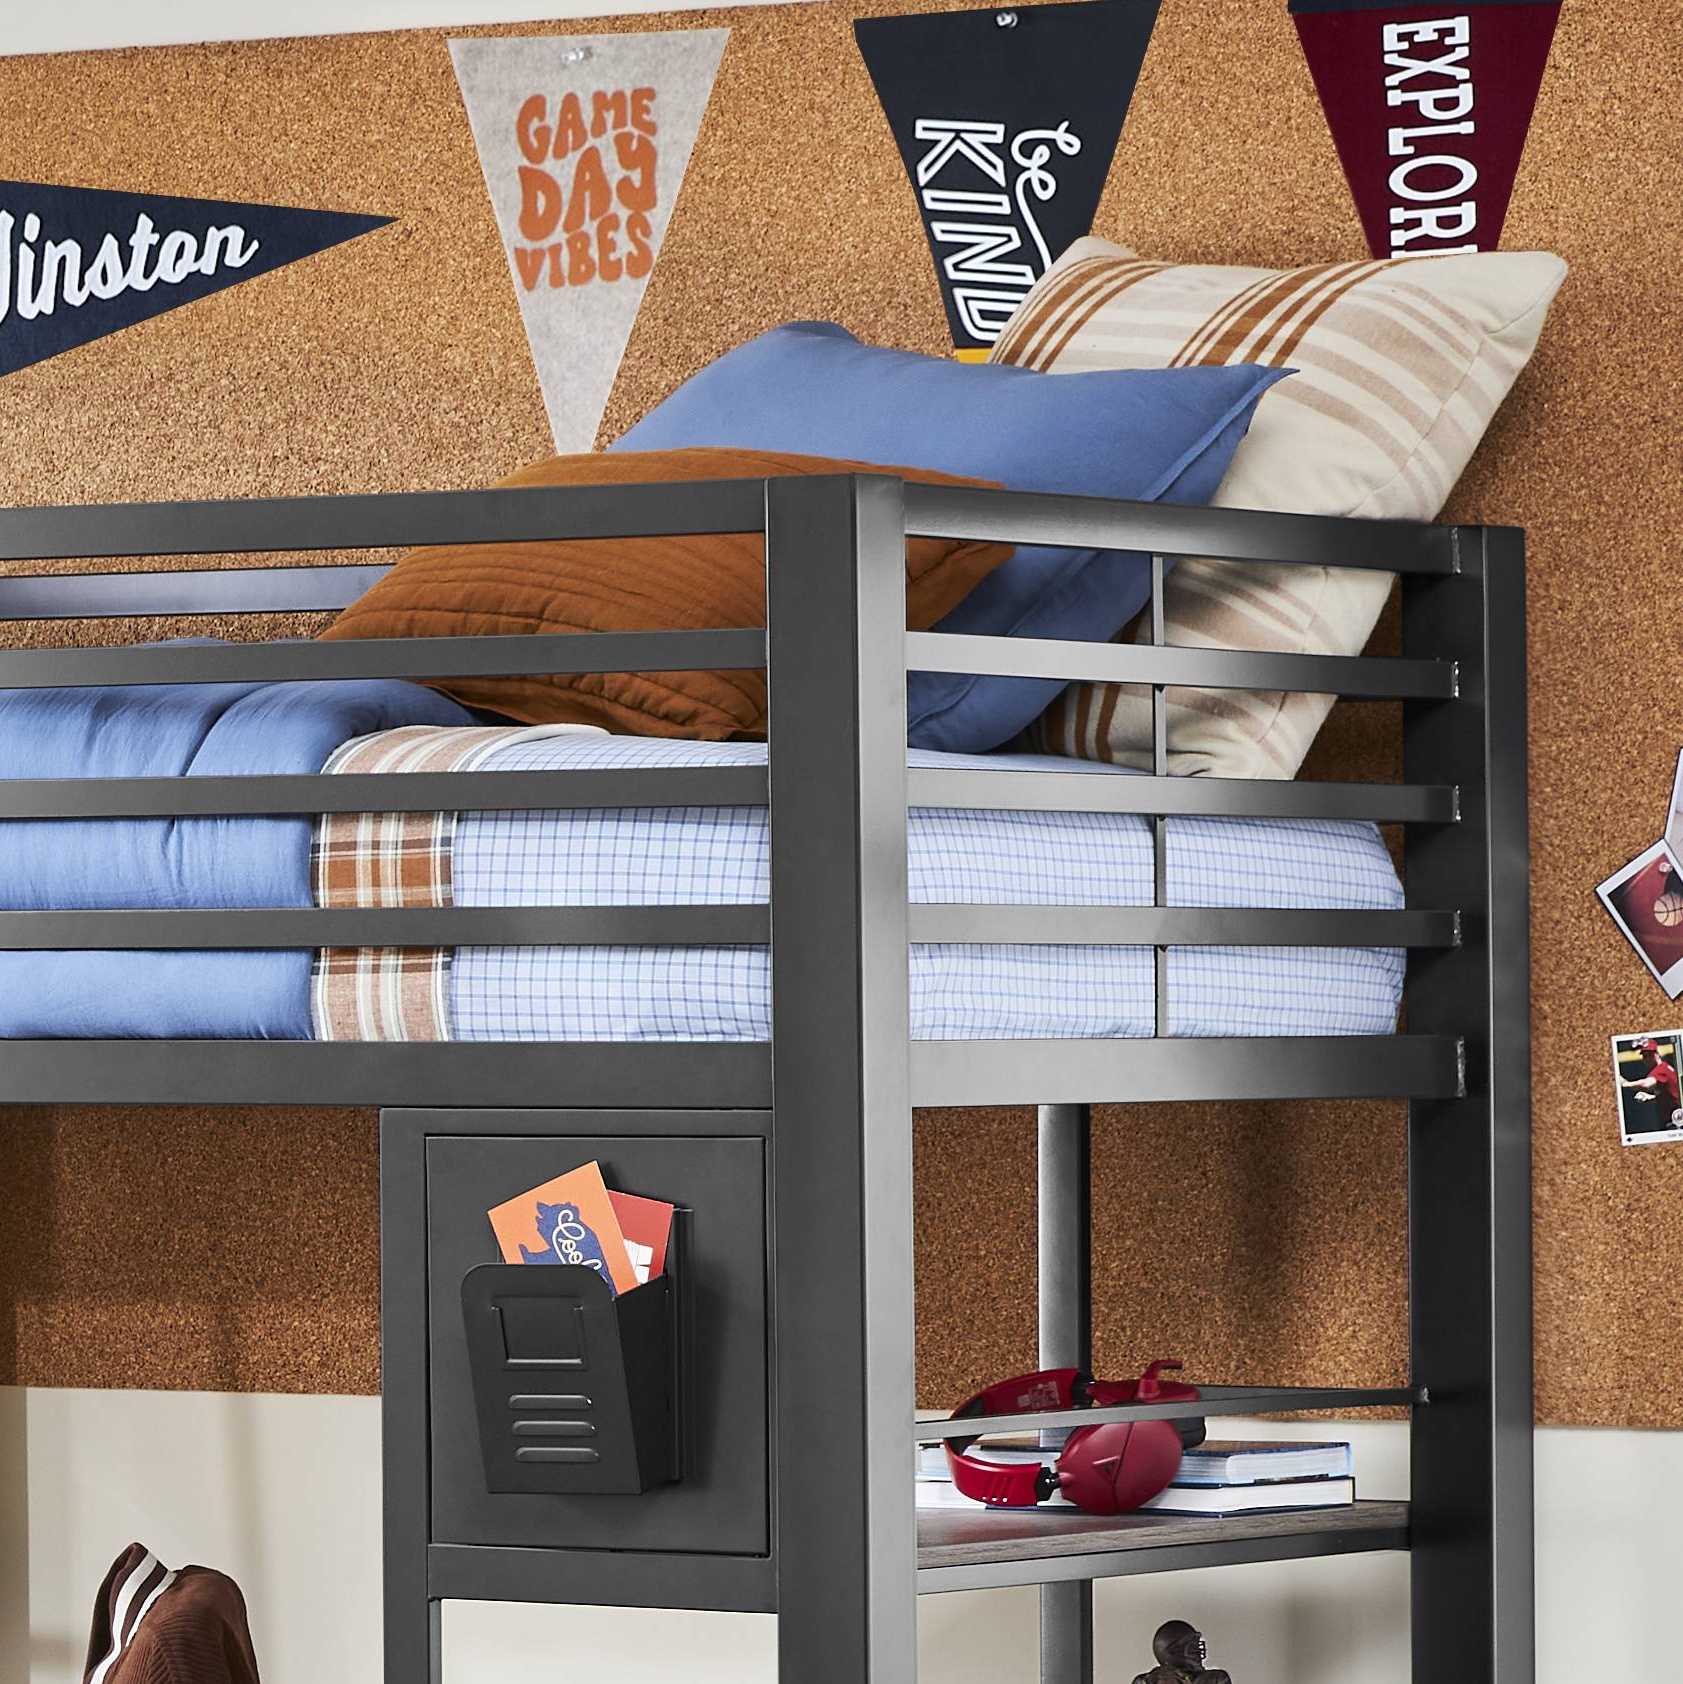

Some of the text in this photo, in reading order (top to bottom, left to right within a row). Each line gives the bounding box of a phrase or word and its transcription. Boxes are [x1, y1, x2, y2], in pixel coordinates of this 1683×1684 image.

[516, 87, 657, 165] GAME
[518, 131, 657, 242] DAY
[915, 119, 1035, 341] KIND
[514, 210, 653, 292] VIBES
